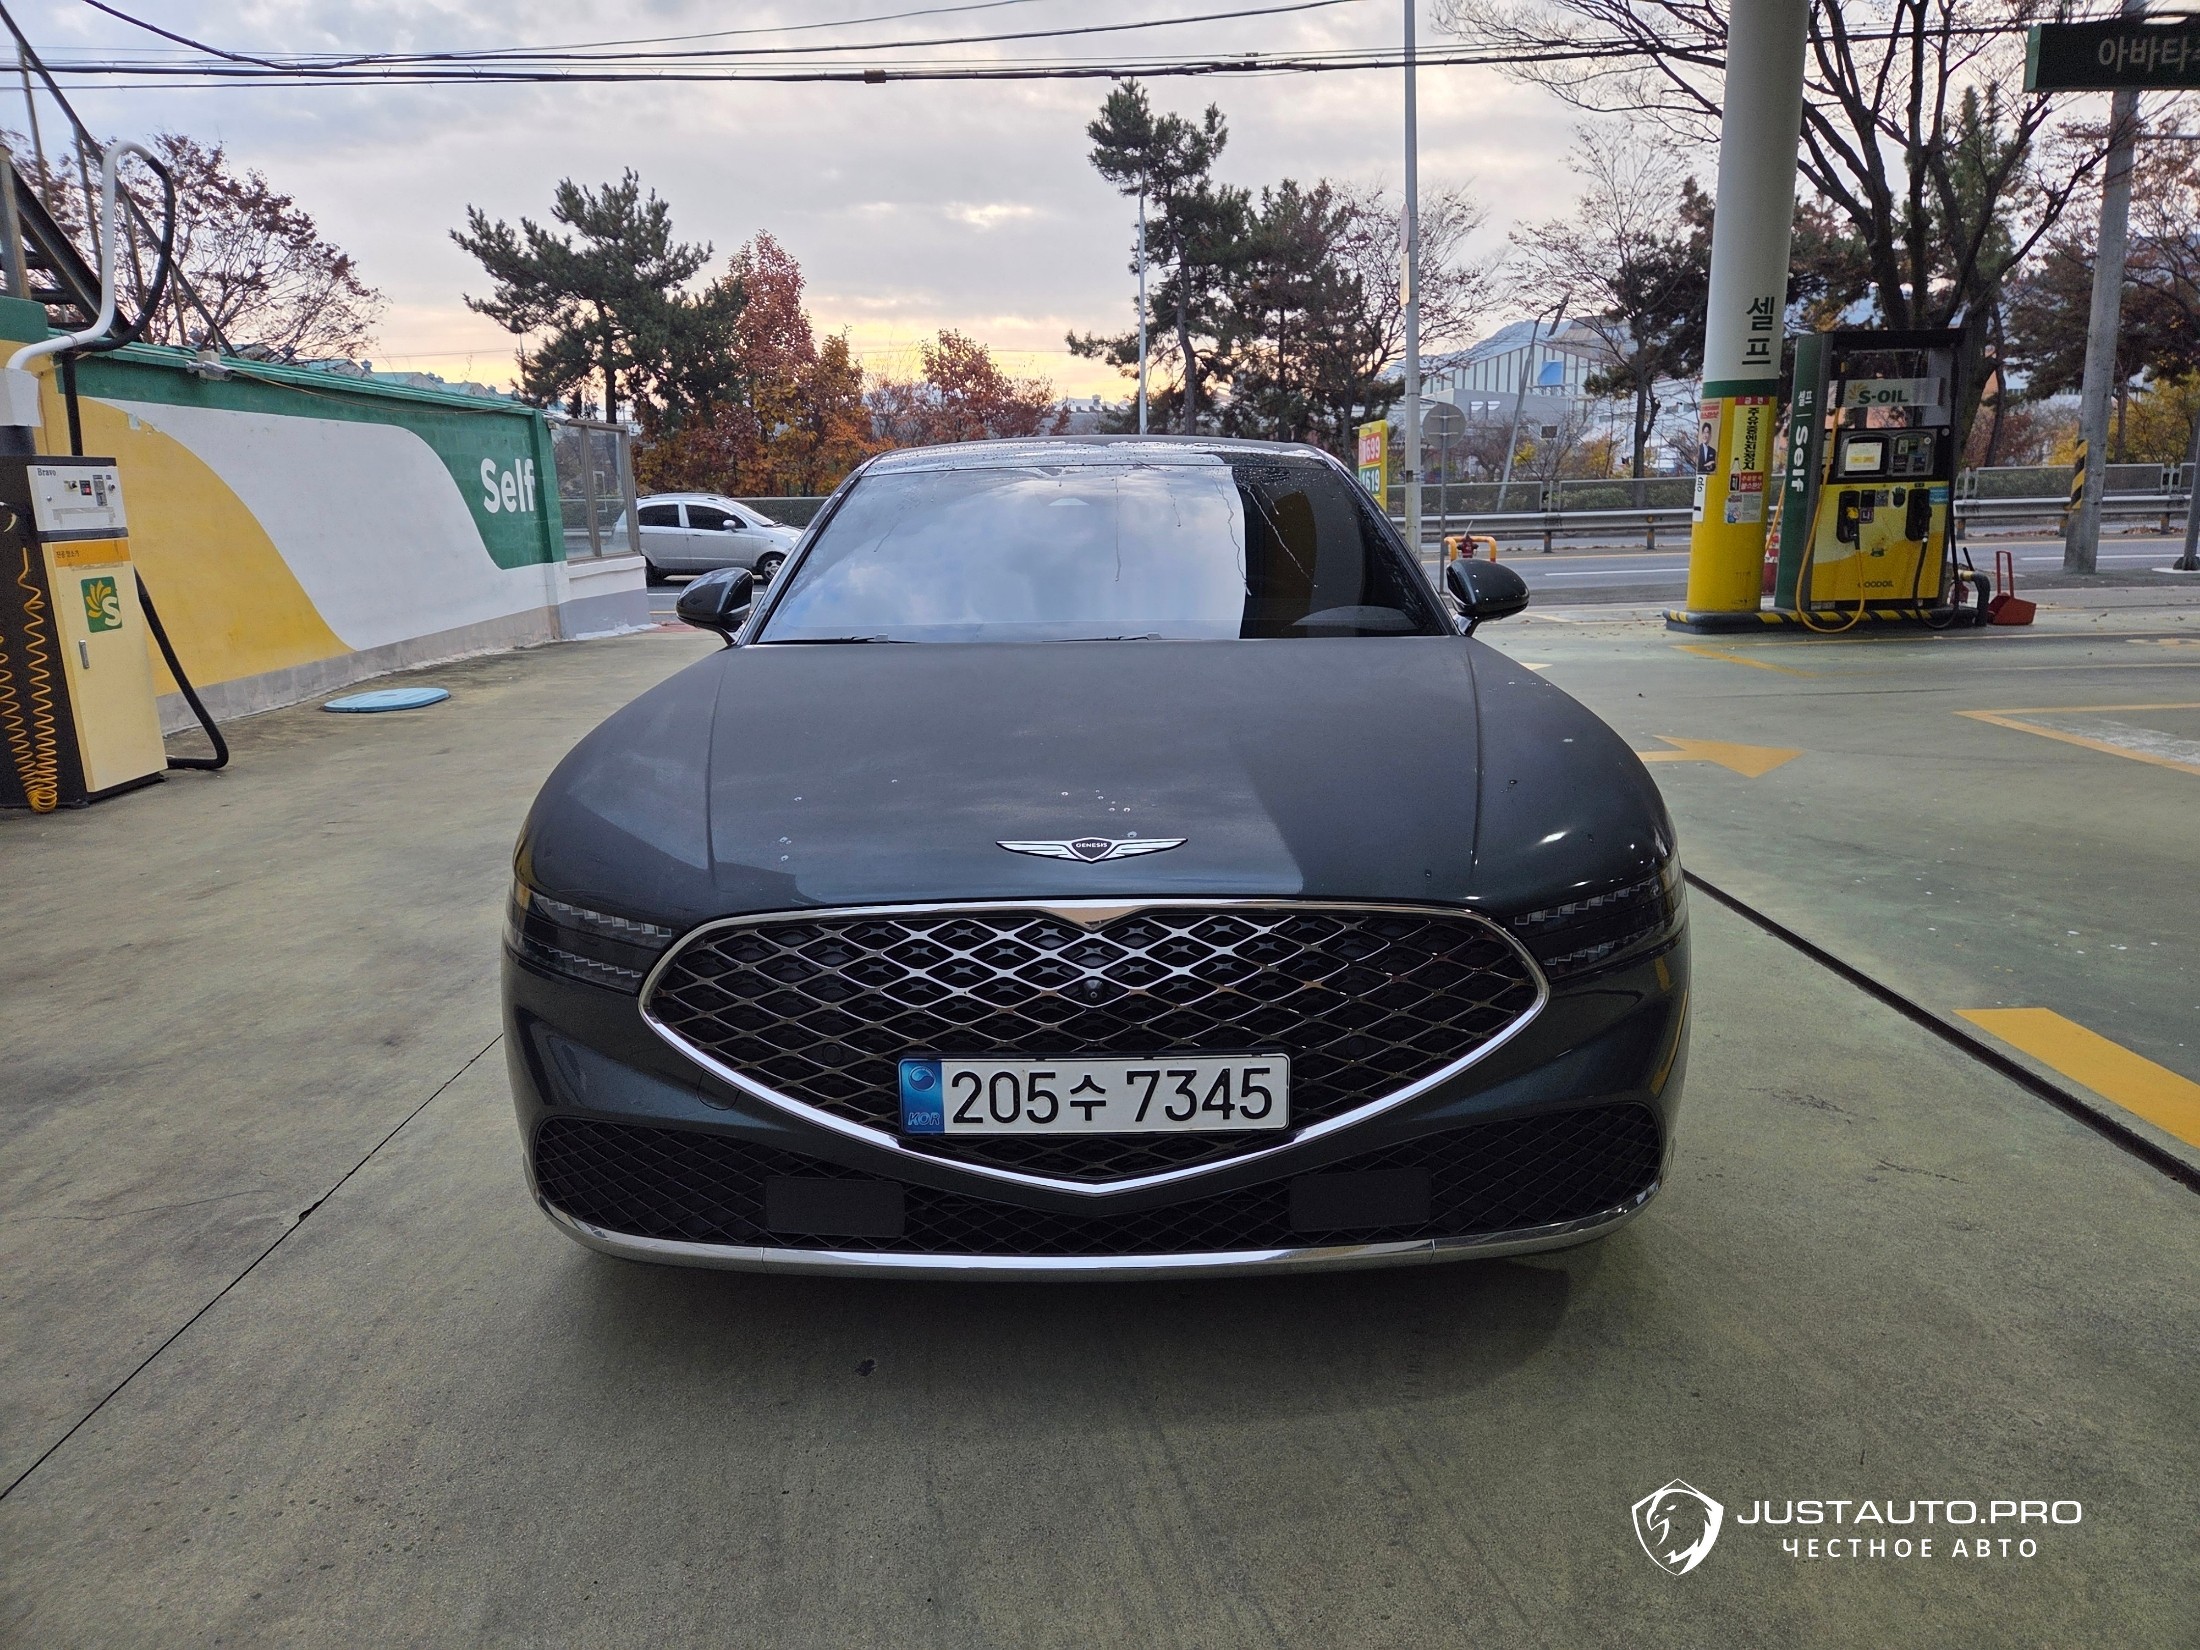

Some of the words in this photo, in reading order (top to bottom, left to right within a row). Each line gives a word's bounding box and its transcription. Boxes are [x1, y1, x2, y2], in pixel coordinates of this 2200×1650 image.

[2099, 35, 2200, 73] 아바타
[1742, 296, 1775, 365] 셀프
[1798, 390, 1813, 407] 셀프
[1858, 389, 1909, 405] S-OIL
[37, 467, 57, 477] Bravo
[1791, 425, 1809, 492] Self
[480, 457, 536, 514] Self
[102, 596, 122, 626] S
[951, 1071, 1106, 1124] 205수
[1126, 1067, 1273, 1122] 7345
[907, 1111, 940, 1126] KOR
